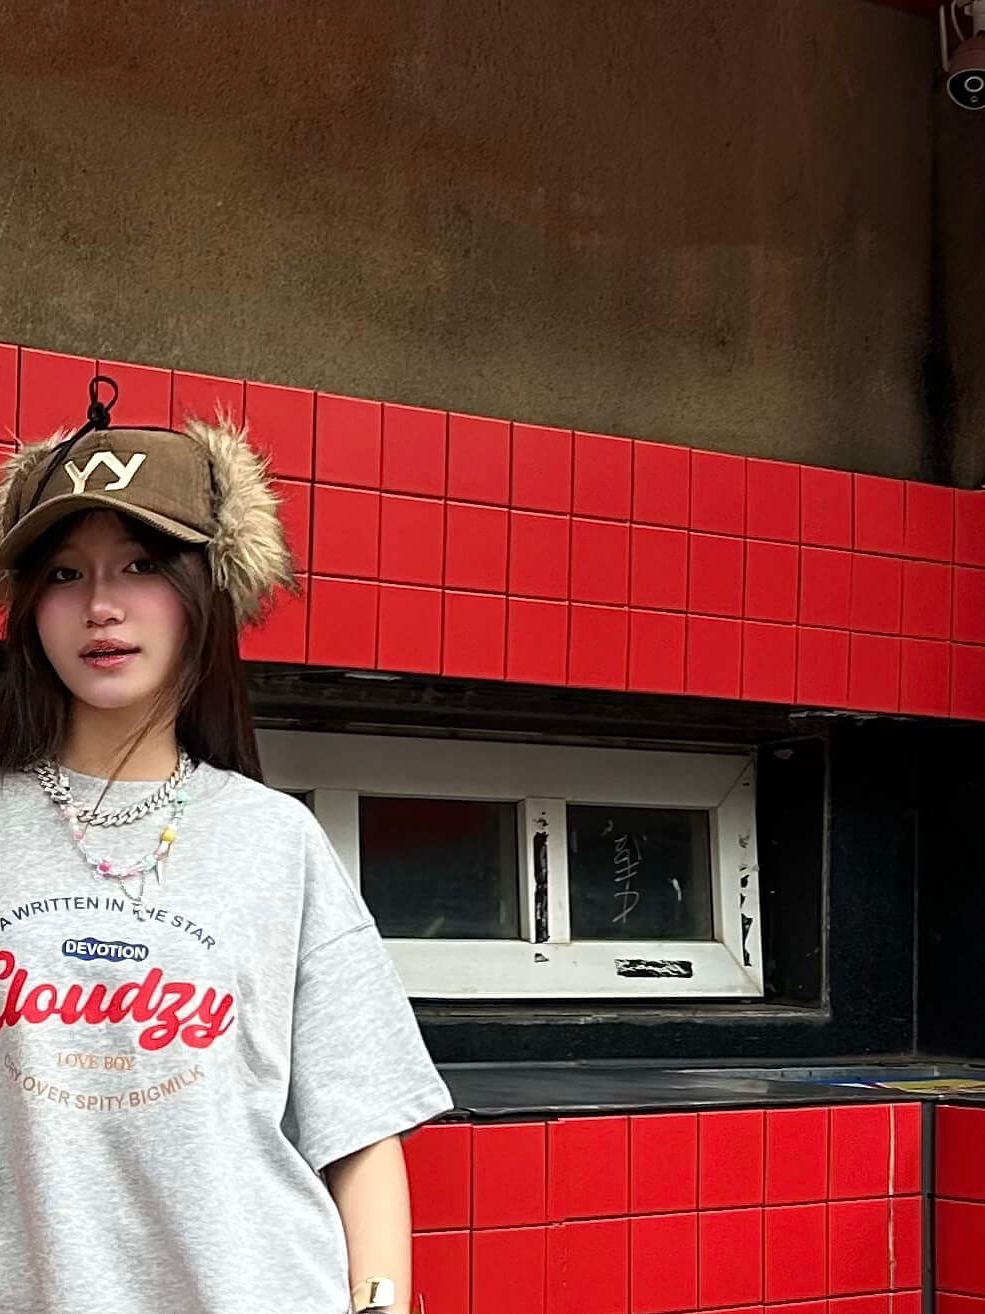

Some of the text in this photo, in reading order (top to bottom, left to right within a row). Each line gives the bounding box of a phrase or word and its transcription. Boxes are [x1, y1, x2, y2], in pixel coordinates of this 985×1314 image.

[0, 916, 12, 932] A
[12, 896, 99, 921] WRITTEN
[105, 897, 125, 912] IN
[170, 915, 216, 950] STAR
[64, 940, 146, 960] DEVOTION
[103, 1055, 135, 1071] BOY
[22, 1076, 71, 1105] OVER
[75, 1093, 125, 1112] SPITY
[129, 1064, 205, 1107] BIGMILK
